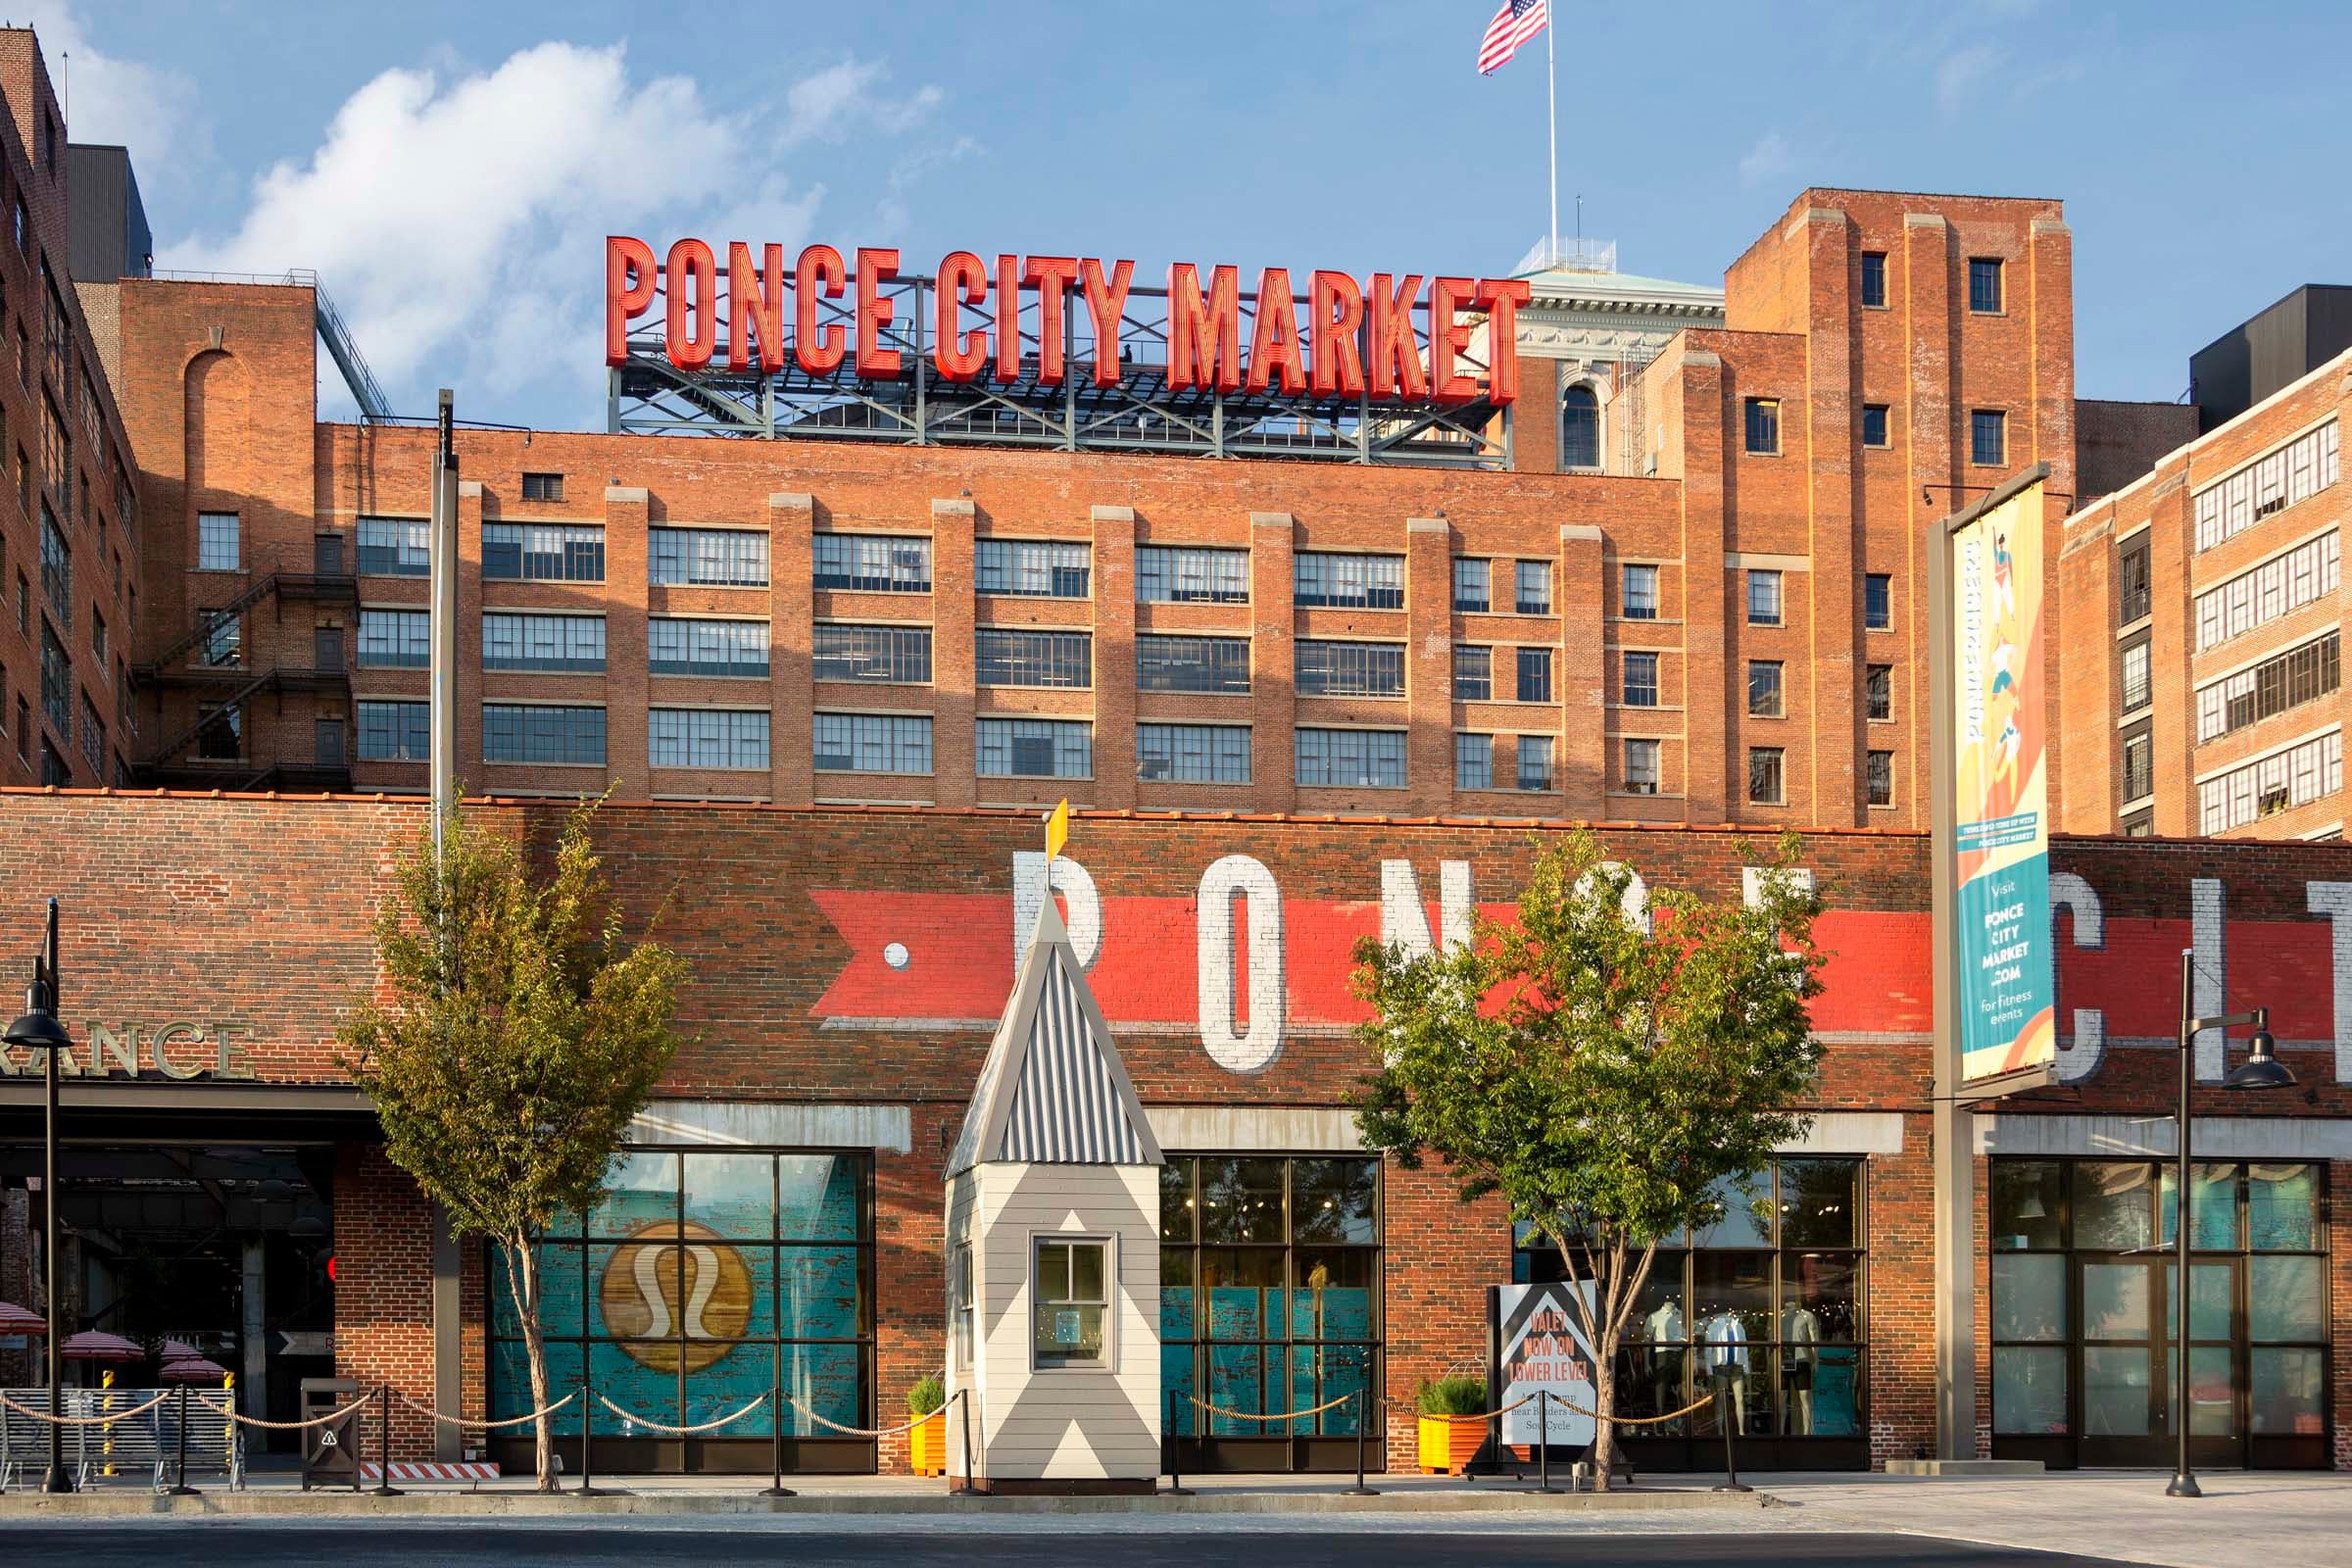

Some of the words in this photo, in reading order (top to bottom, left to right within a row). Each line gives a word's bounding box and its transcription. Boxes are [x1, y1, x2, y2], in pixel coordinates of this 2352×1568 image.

[606, 235, 901, 378] PONCE
[935, 250, 1136, 388] CITY
[1167, 263, 1531, 407] MARKET
[1990, 881, 2015, 898] Visit
[1984, 903, 2024, 929] PONCE
[1991, 925, 2019, 946] CITY
[1983, 942, 2029, 969] MARKET
[1981, 998, 1996, 1013] for
[1998, 990, 2032, 1010] fitness
[1531, 1311, 1567, 1332] VALET
[1523, 1337, 1552, 1357] NOW
[1557, 1336, 1575, 1357] ON
[1509, 1360, 1550, 1382] LOWER
[1554, 1359, 1589, 1382] LEVEL
